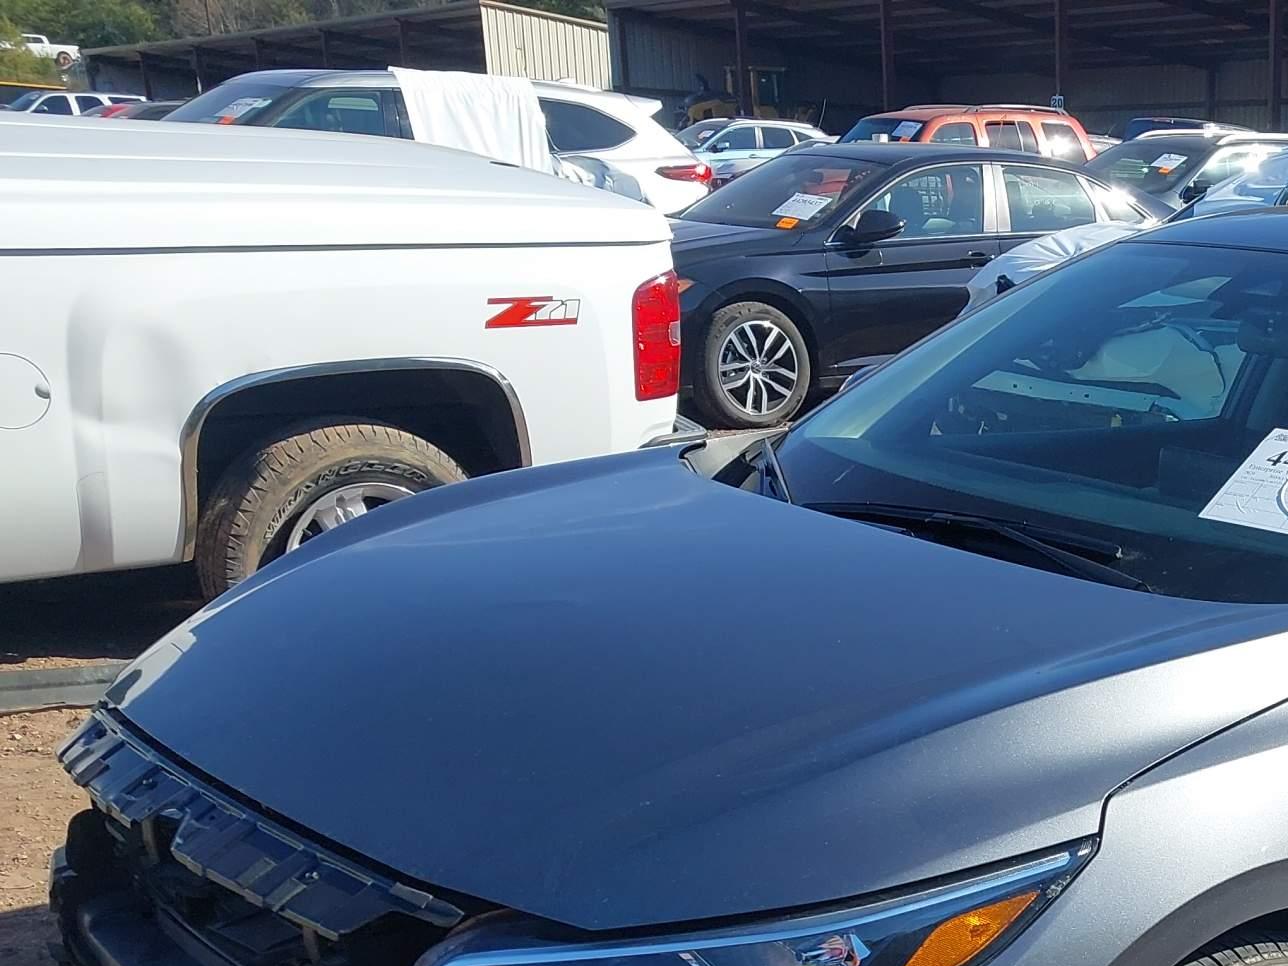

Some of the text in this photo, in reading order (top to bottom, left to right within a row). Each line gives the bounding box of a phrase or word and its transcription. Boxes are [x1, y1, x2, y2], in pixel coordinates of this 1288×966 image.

[1051, 98, 1063, 108] 20
[485, 296, 580, 329] Z71
[264, 459, 429, 542] WRANGLER
